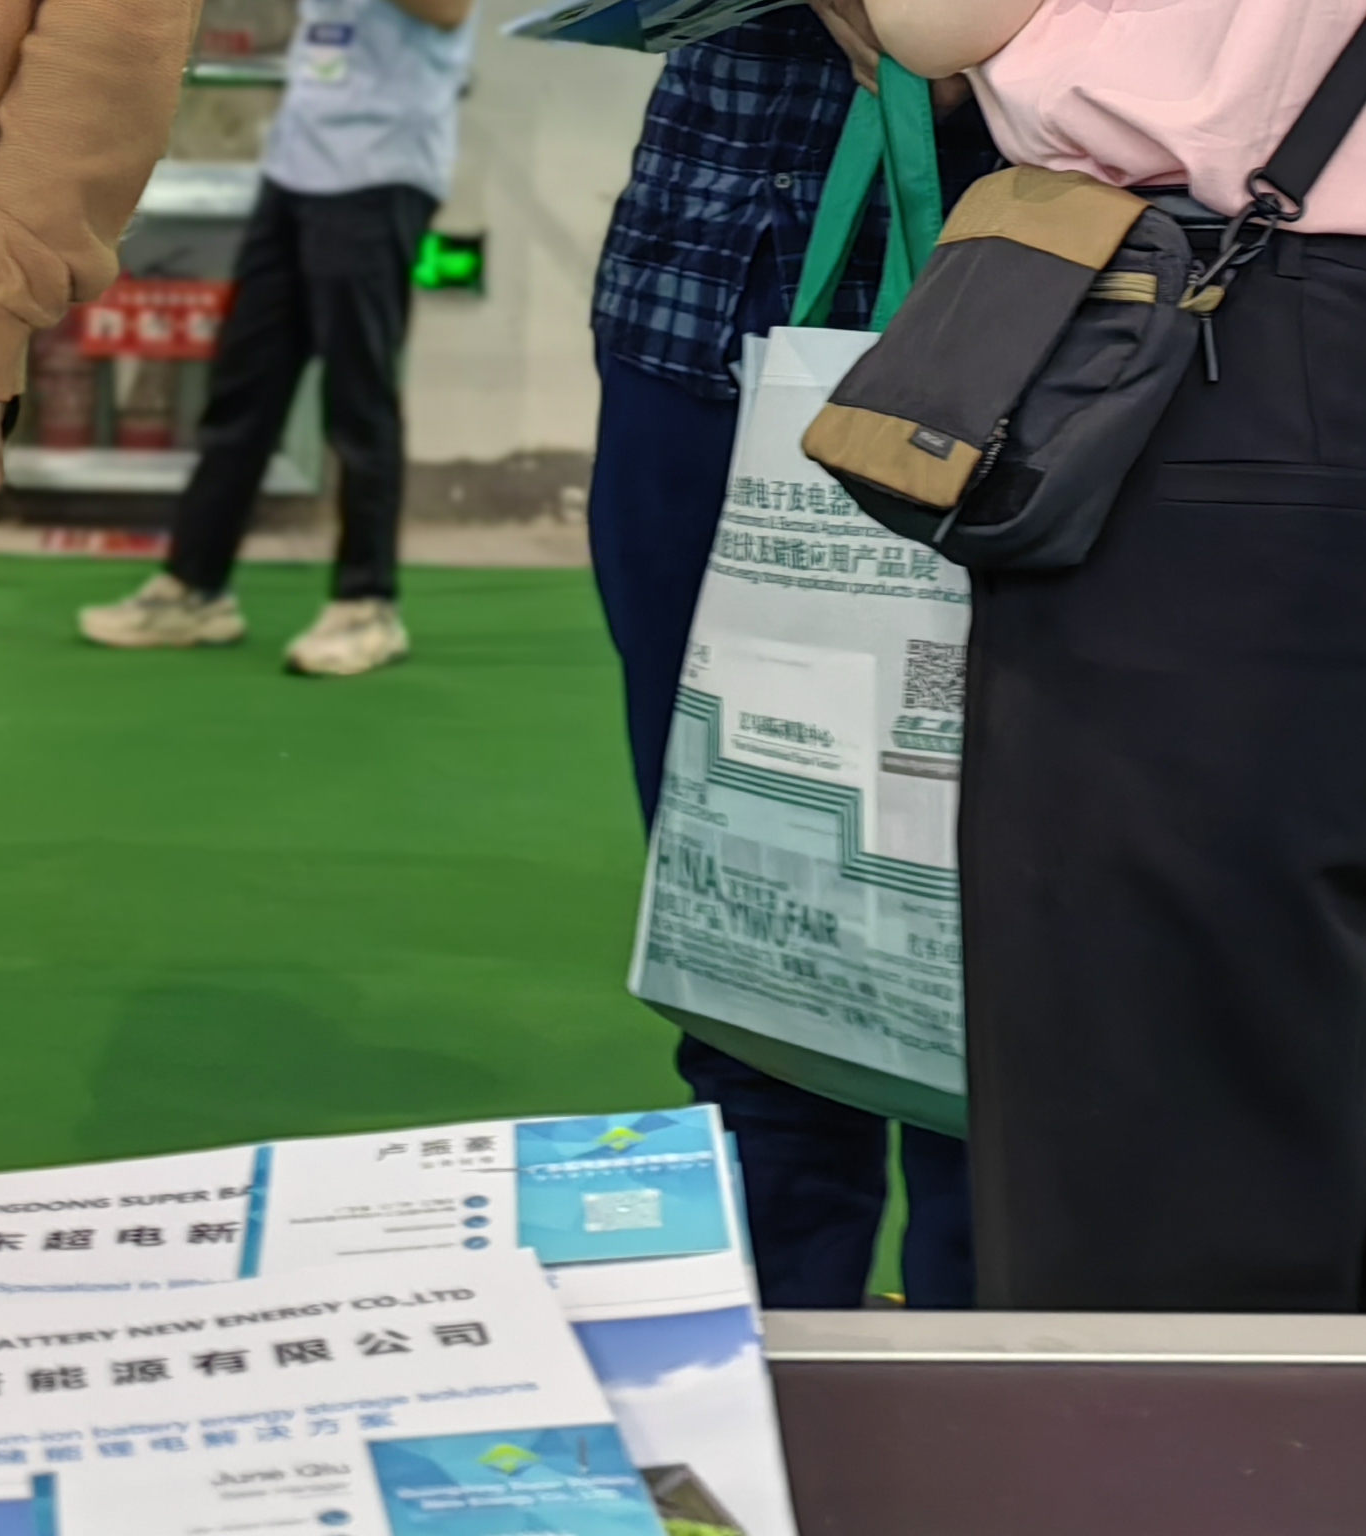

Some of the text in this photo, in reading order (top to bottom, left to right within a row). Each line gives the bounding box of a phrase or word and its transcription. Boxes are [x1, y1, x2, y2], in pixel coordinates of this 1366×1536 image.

[119, 1190, 211, 1207] SUPER
[126, 1318, 207, 1338] NEW
[215, 1299, 345, 1328] ENERGY
[199, 1408, 296, 1430] energy
[304, 1393, 410, 1416] storage
[417, 1380, 539, 1403] solutions
